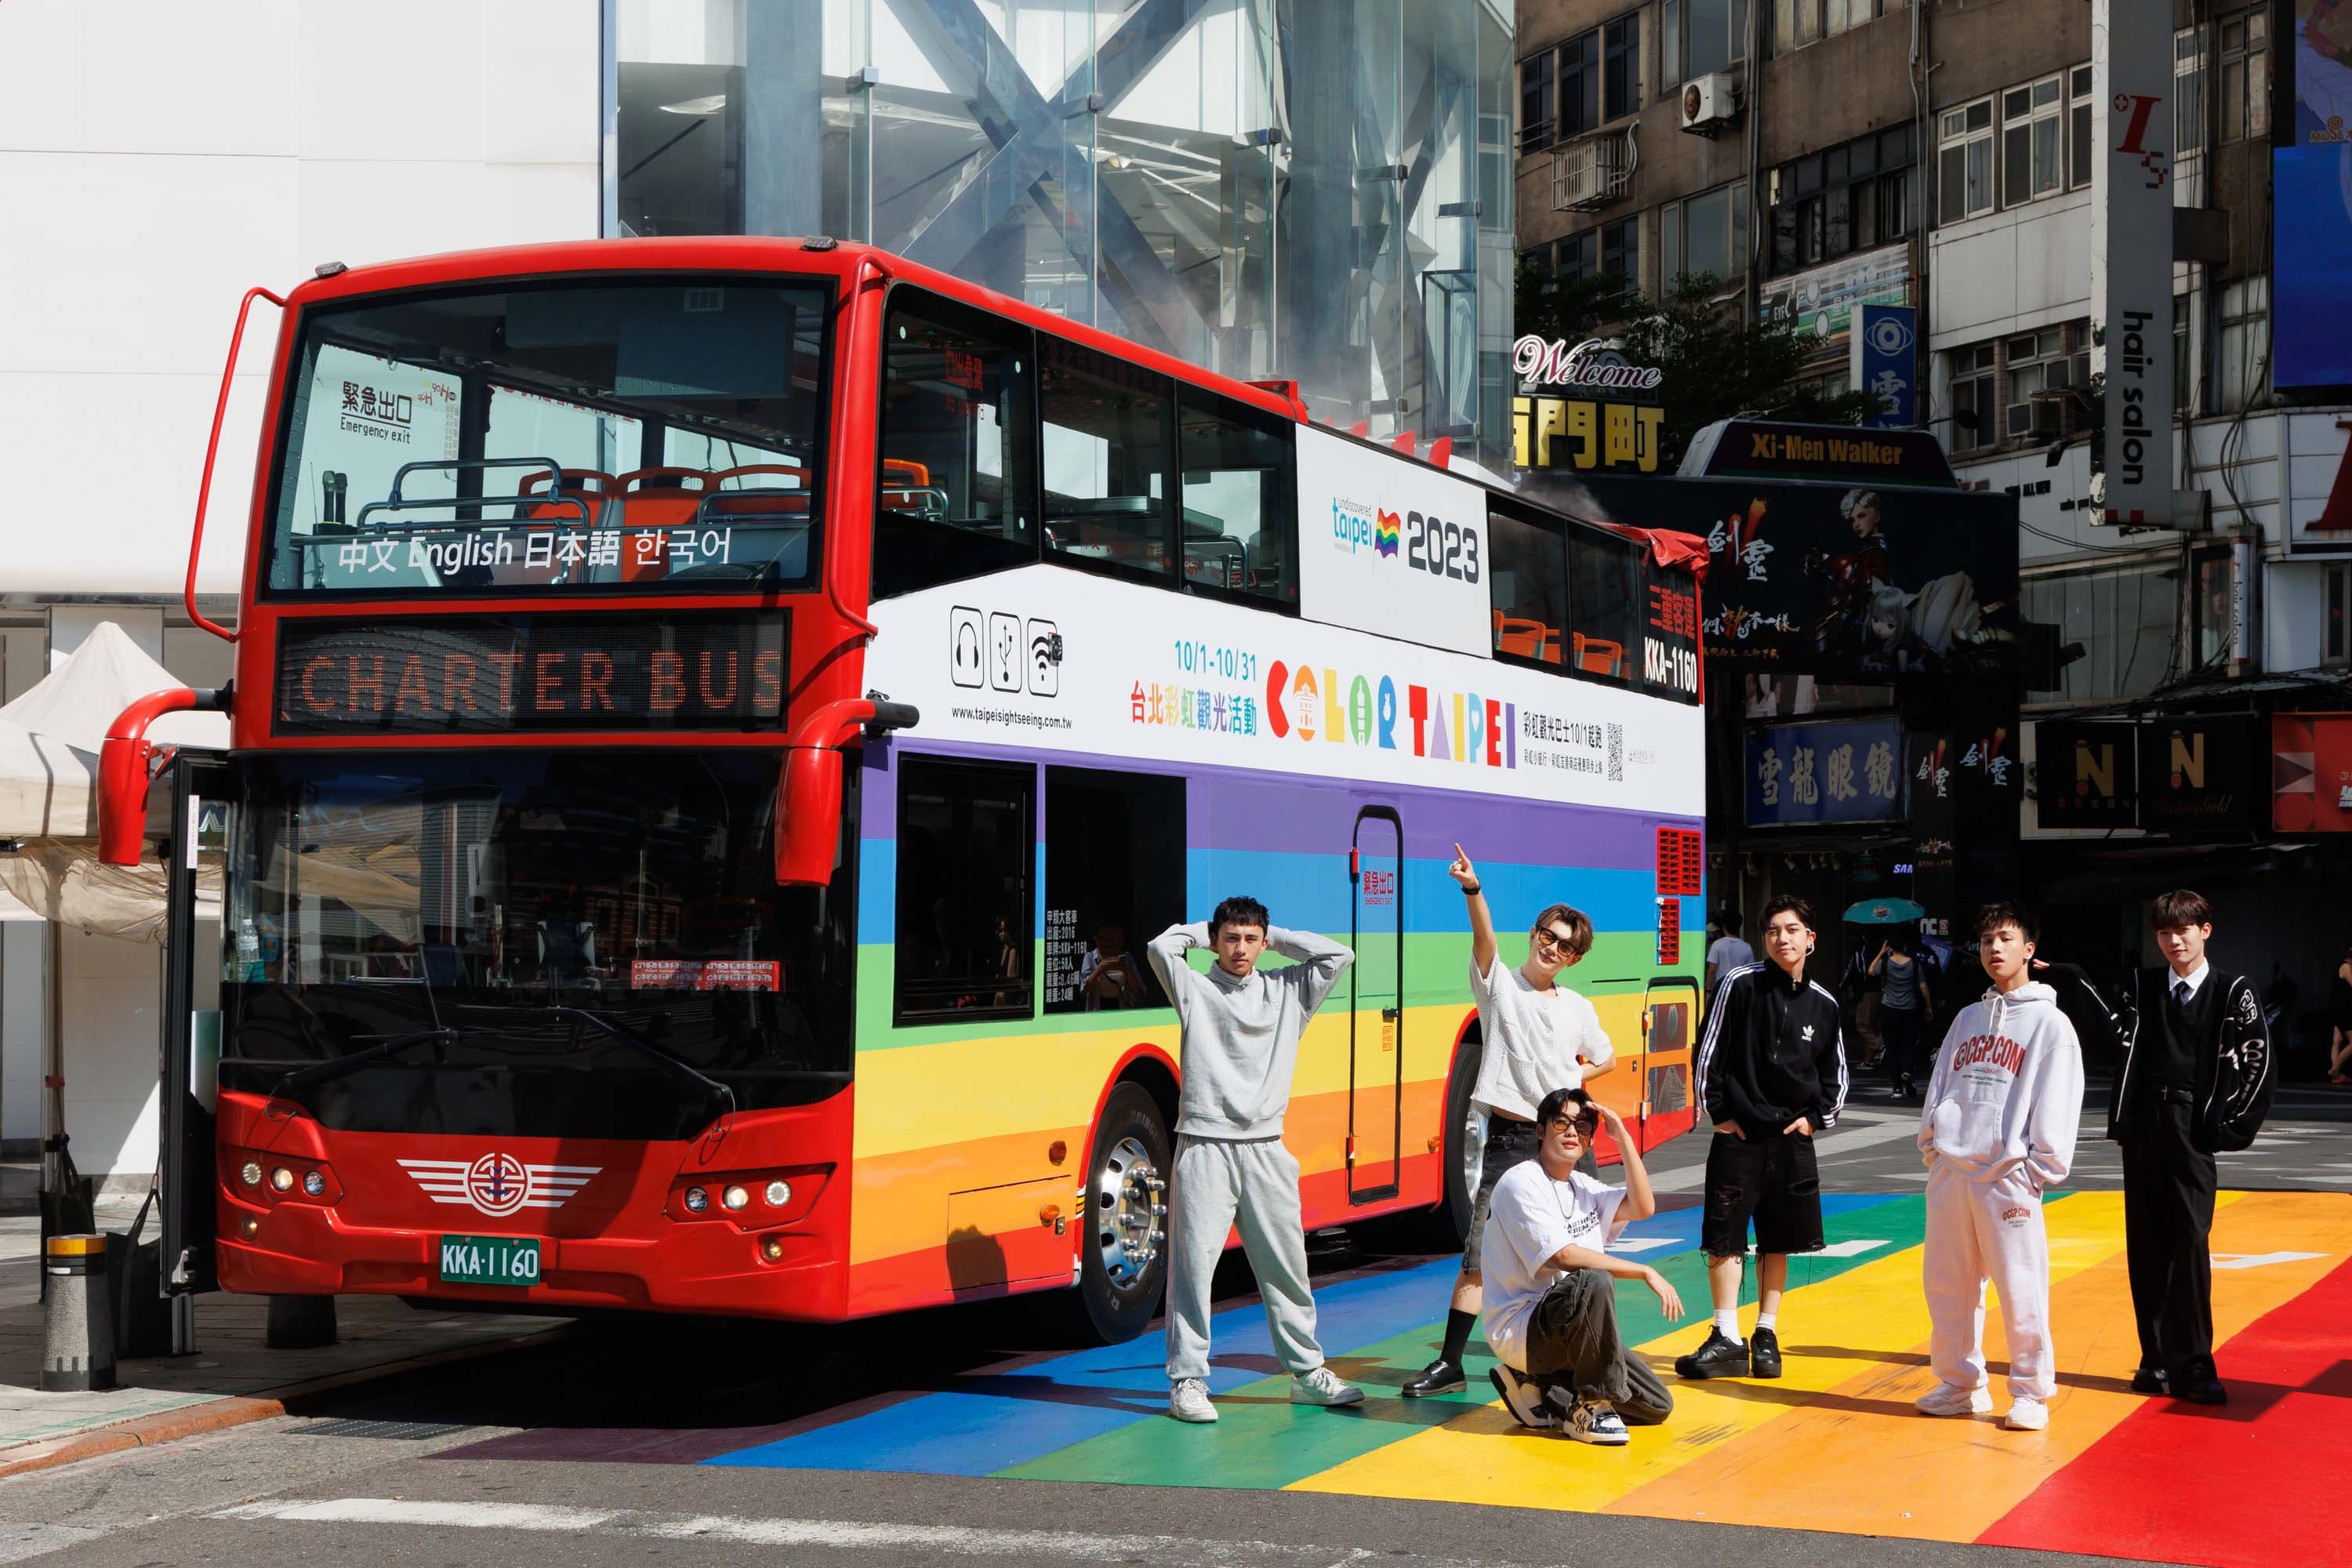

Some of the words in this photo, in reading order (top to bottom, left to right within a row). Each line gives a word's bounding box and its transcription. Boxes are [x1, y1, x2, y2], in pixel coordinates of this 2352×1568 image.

[1513, 334, 1662, 389] Welcome
[2123, 310, 2153, 377] hair
[342, 380, 413, 425] 緊急出口
[340, 416, 390, 439] Emergency
[391, 430, 411, 445] exit
[1751, 433, 1824, 462] Xi-Men
[1826, 438, 1904, 465] Walker
[2122, 387, 2152, 484] salon
[1332, 496, 1372, 554] taipei
[1338, 498, 1372, 517] undiscovered
[339, 538, 400, 574] 中文
[408, 532, 513, 575] English
[524, 530, 620, 568] 日本語
[635, 526, 731, 565] 한국어
[1407, 510, 1479, 585] 2023
[301, 652, 613, 712] CHARTER
[650, 649, 782, 709] BUS
[1174, 639, 1256, 682] 10/1-10/31
[1644, 636, 1697, 694] KKA-1160
[951, 706, 1073, 730] www.taipeisightseeing.com.tw
[1131, 679, 1257, 738] 台北彩虹觀光活動
[1266, 659, 1397, 750] COLOR
[1408, 684, 1517, 770] TAIPEI
[1523, 710, 1602, 749] 彩虹觀光巴士10/1起跑
[1757, 740, 1897, 806] 雪龍眼鏡
[1364, 870, 1394, 895] 緊急出口
[1047, 909, 1078, 925] 甲類大客車
